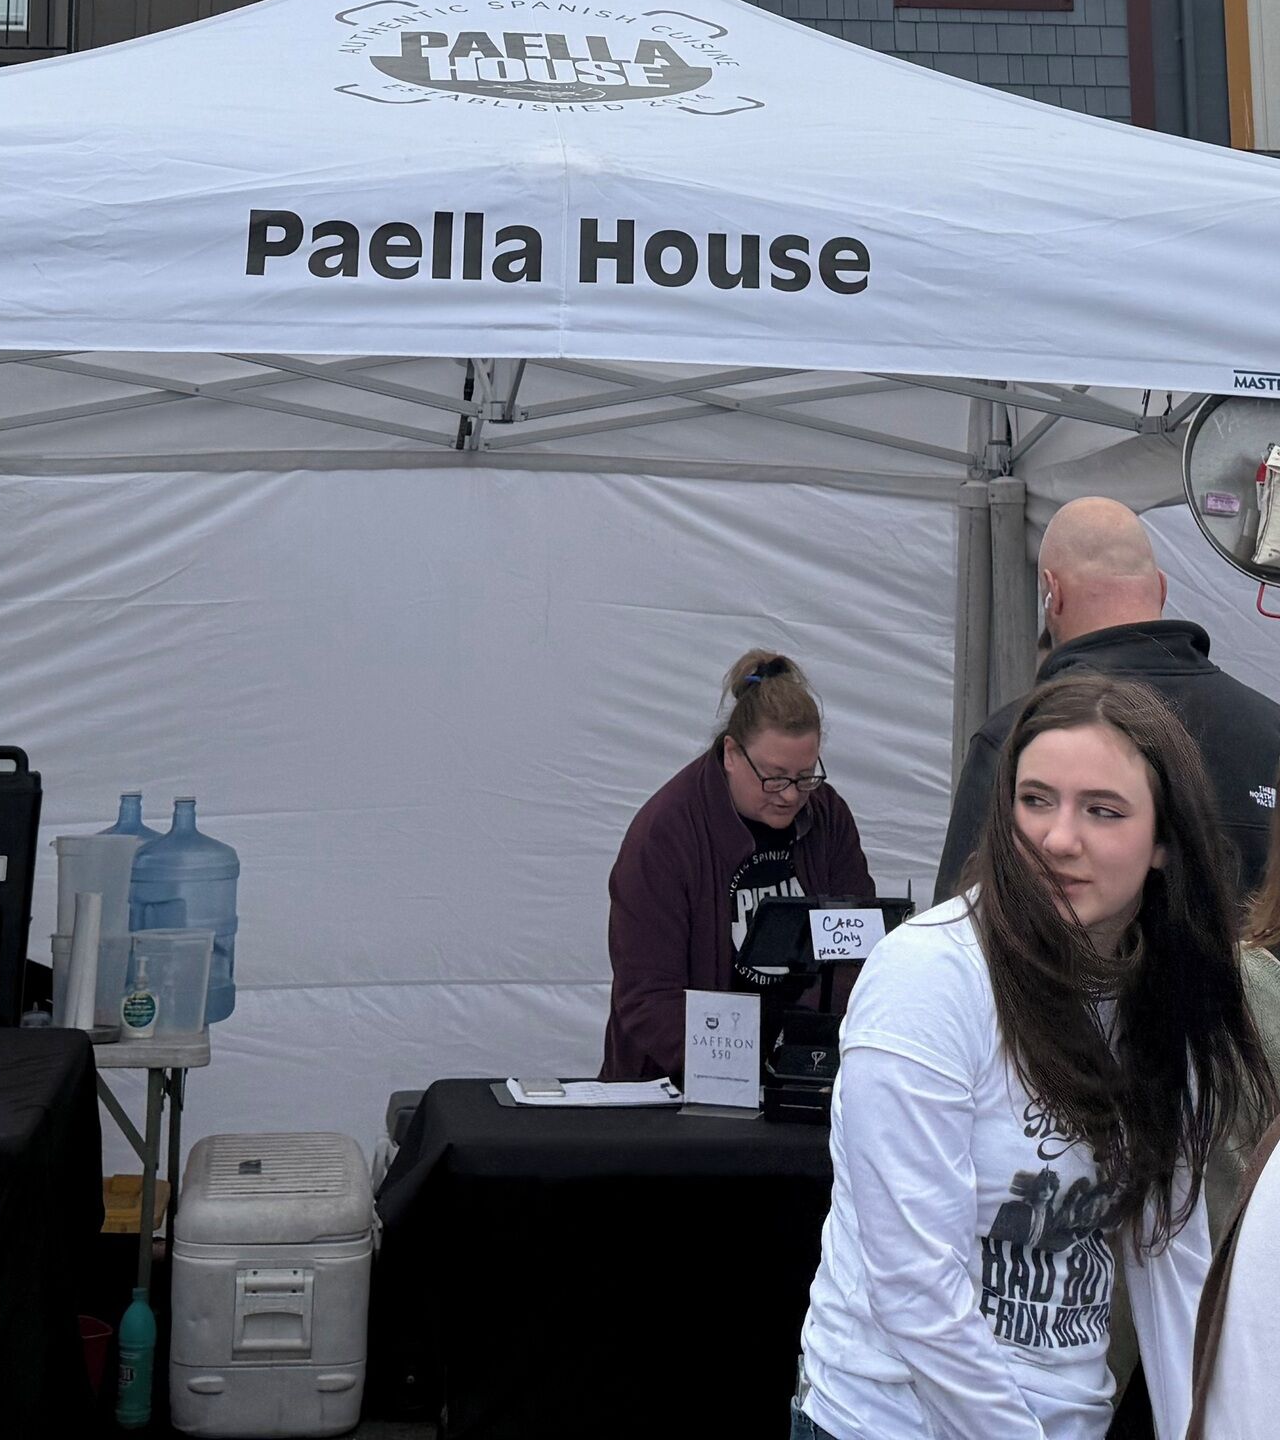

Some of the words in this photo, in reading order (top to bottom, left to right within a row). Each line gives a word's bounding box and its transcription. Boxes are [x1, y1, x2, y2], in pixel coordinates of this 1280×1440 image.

[338, 4, 469, 55] AUTHENTIC
[487, 0, 637, 24] SPANISH
[651, 25, 740, 67] CUISINE
[401, 31, 691, 68] PAELLA
[427, 56, 671, 89] HOUSE
[382, 83, 624, 112] ESTABLISHED
[642, 93, 716, 107] 2014
[245, 209, 543, 284] Paella
[578, 218, 871, 295] House
[822, 915, 865, 932] CARD
[832, 931, 863, 947] Only
[817, 947, 851, 958] please
[692, 1034, 754, 1050] SAFFRON
[711, 1049, 731, 1060] $50
[981, 1237, 1056, 1304] BAD
[979, 1288, 1054, 1349] FROM
